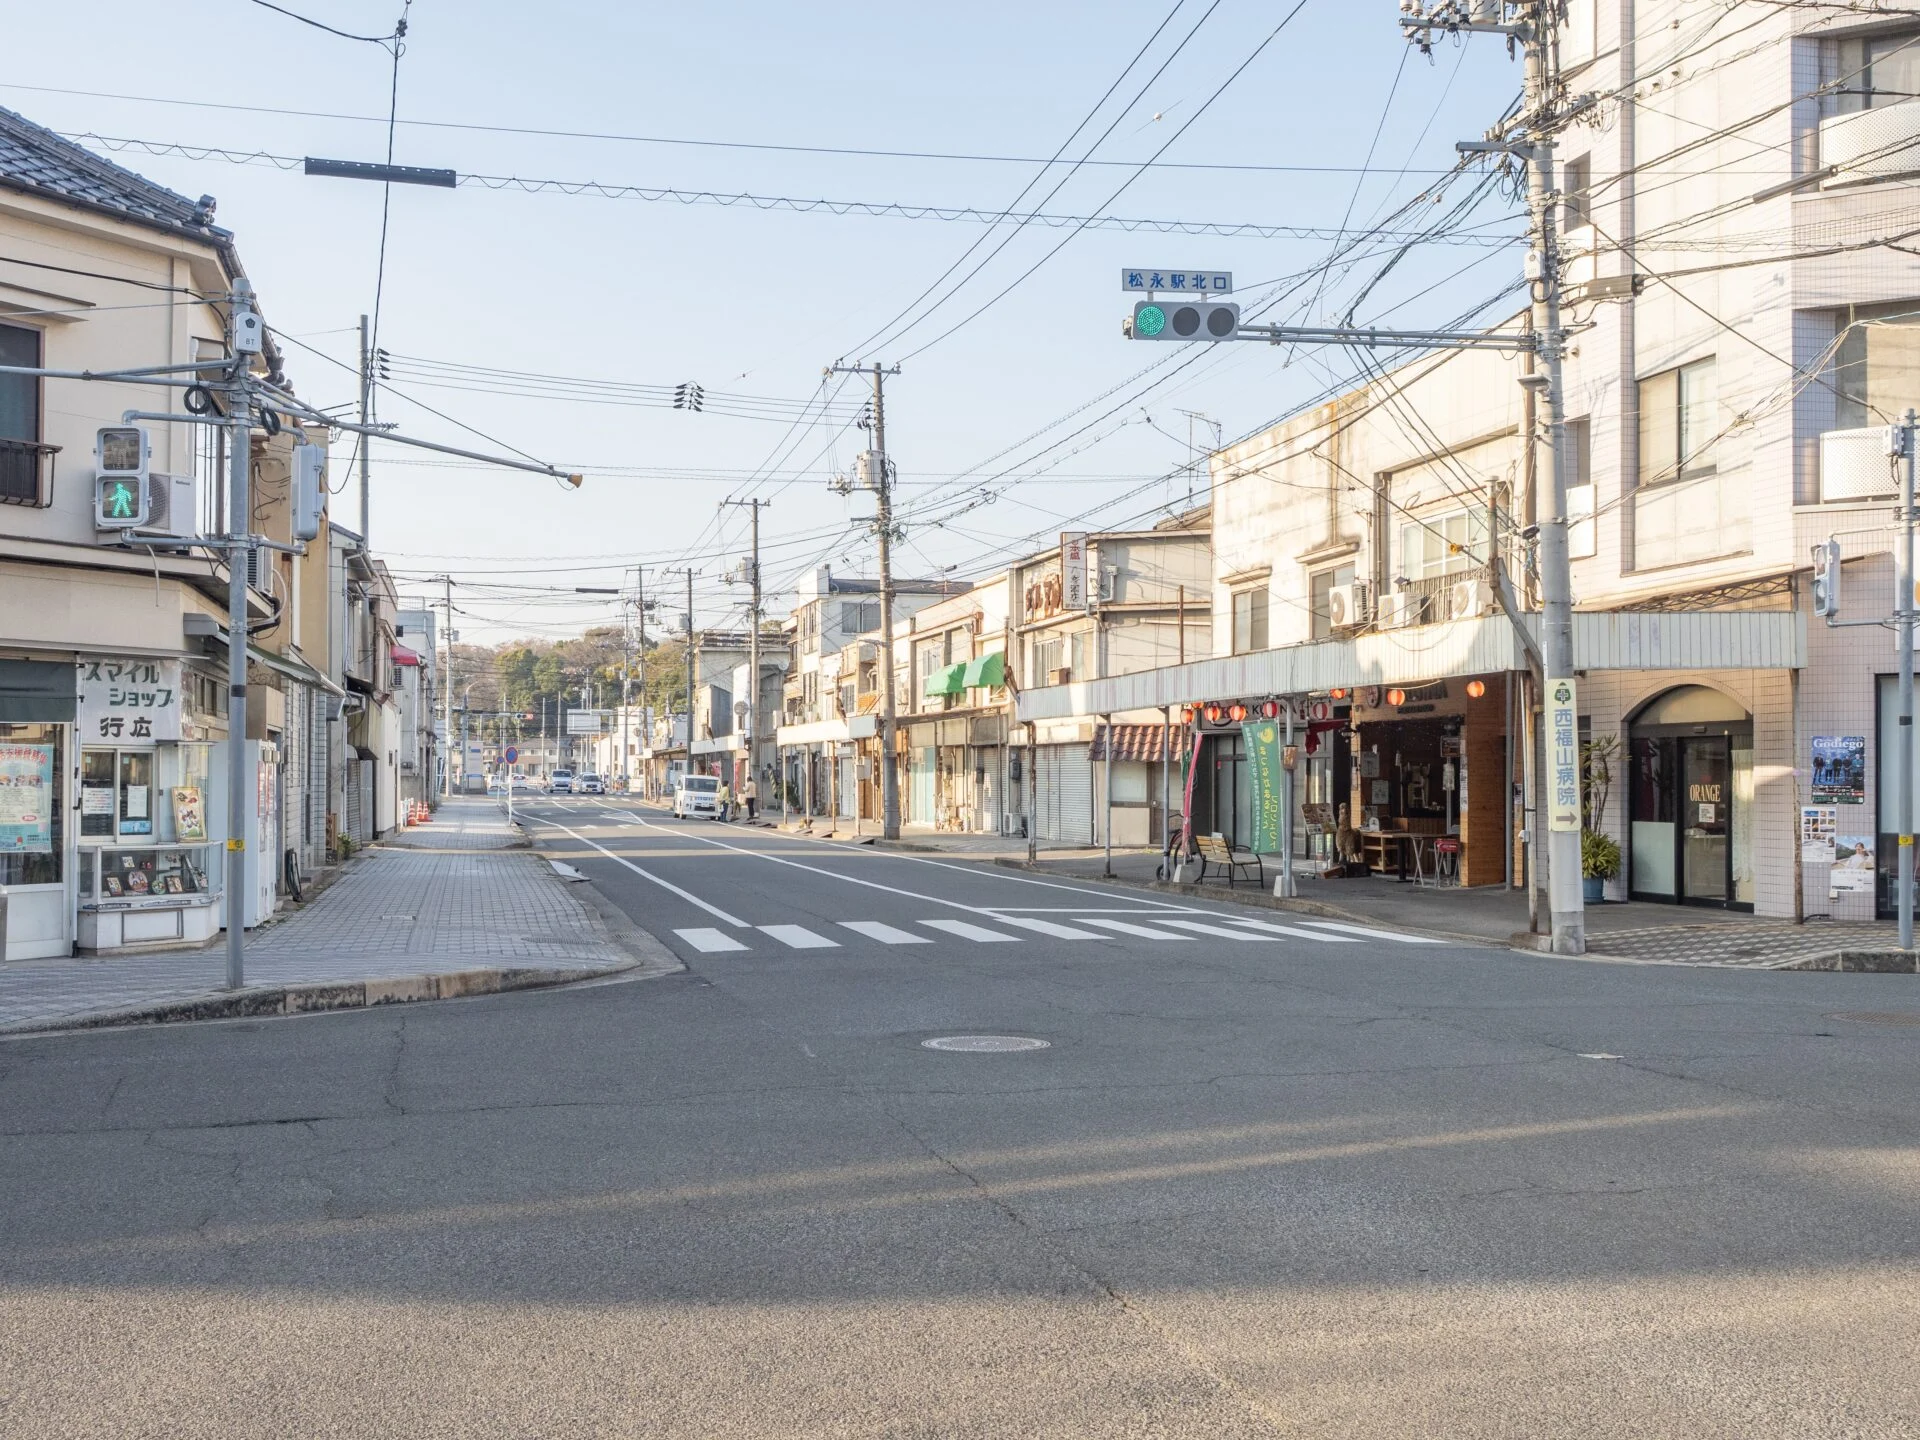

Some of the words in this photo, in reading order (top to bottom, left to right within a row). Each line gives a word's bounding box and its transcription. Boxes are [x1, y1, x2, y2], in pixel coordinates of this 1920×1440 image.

[1128, 272, 1226, 290] 松永駅北口
[85, 662, 160, 684] スマイル
[109, 687, 174, 707] ショップ
[100, 716, 152, 738] 行広
[1813, 738, 1864, 751] Godiego
[1554, 708, 1576, 806] 西福山病院
[1689, 784, 1721, 802] ORANGE
